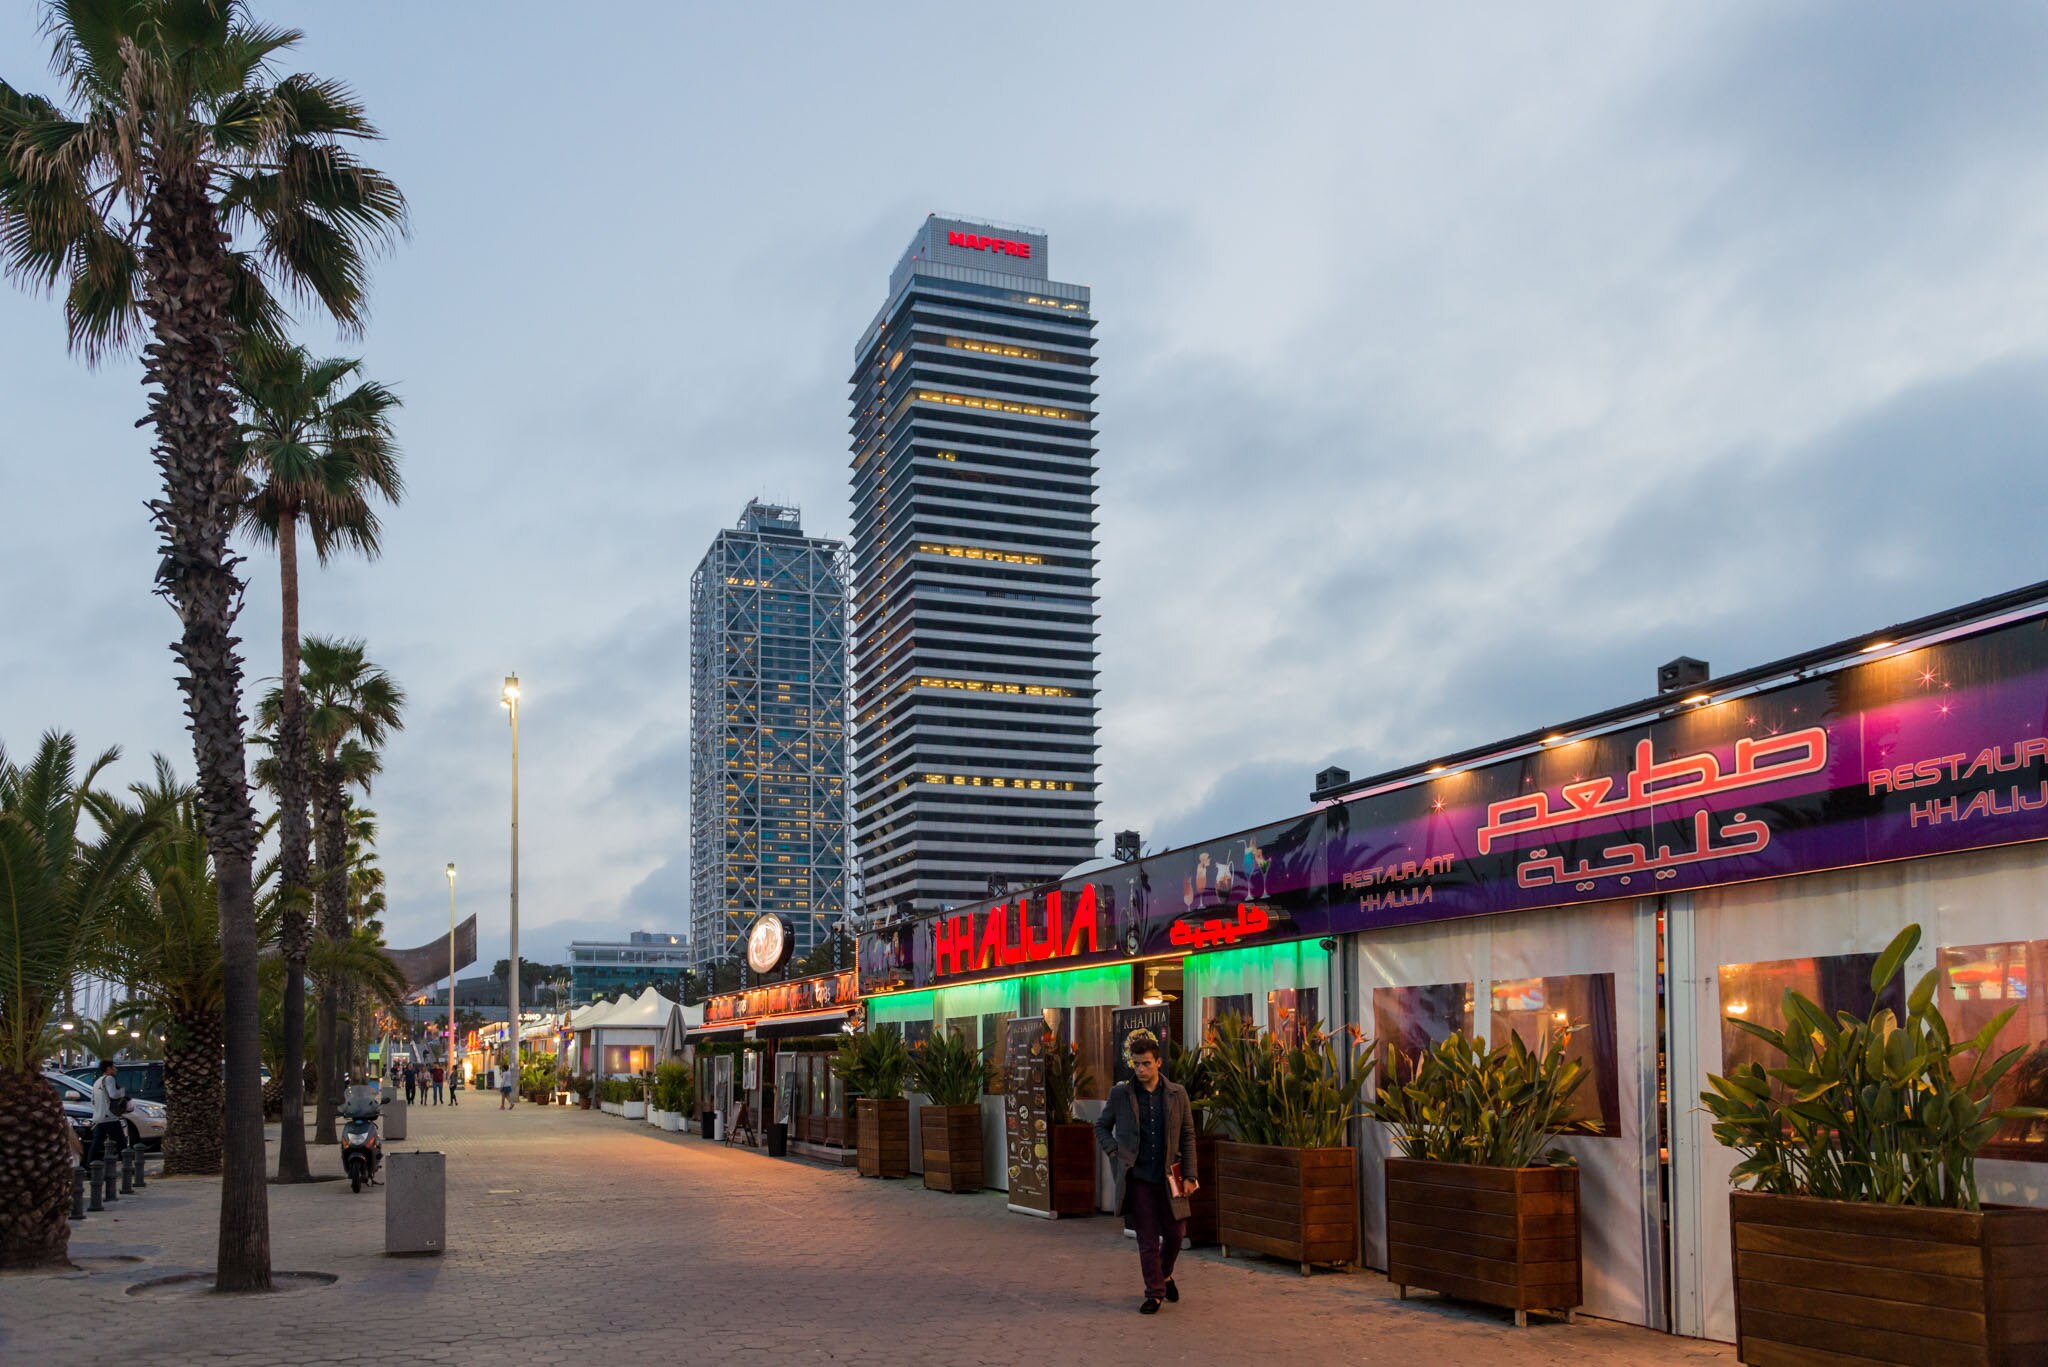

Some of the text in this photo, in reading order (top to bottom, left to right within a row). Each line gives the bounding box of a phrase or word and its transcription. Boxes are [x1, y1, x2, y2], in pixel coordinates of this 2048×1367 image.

[948, 230, 1031, 258] MAPFRE
[1868, 737, 2048, 796] RESTAUR
[1343, 853, 1455, 890] RESTAURANT
[1517, 810, 1770, 891] خليجية
[935, 882, 1098, 977] KHALIJIA
[1170, 903, 1269, 949] خليجية
